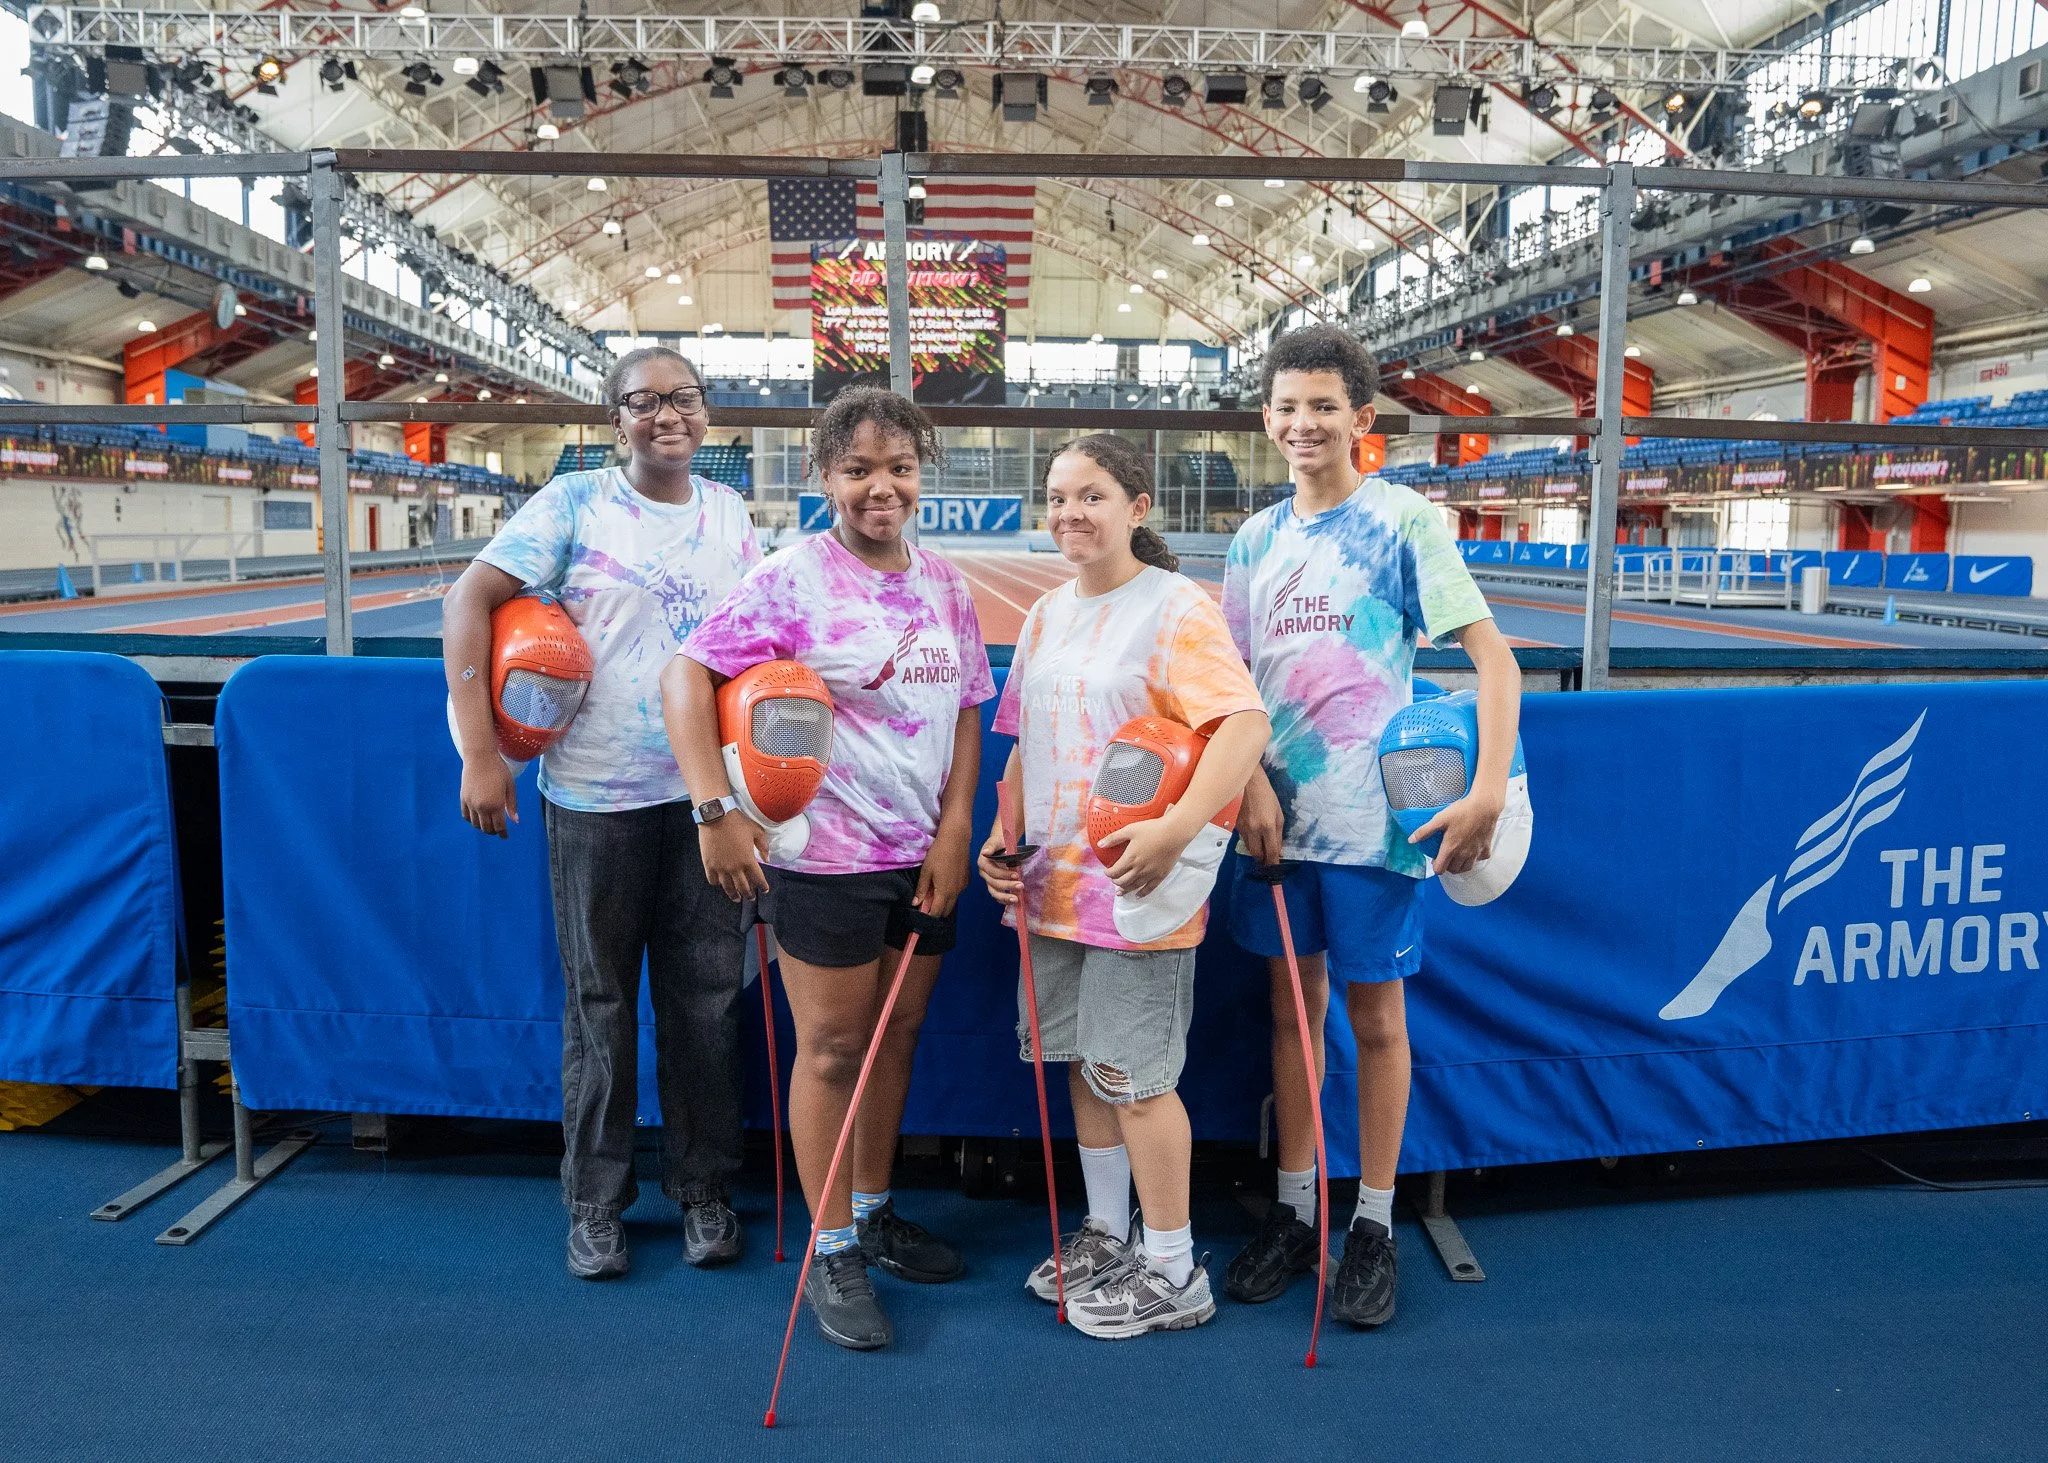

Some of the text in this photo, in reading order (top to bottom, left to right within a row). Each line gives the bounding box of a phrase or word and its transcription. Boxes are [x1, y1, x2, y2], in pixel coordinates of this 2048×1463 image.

[850, 271, 880, 286] DID
[927, 306, 946, 317] the
[859, 318, 877, 329] the
[855, 330, 885, 343] doing
[958, 331, 976, 342] the
[928, 343, 961, 354] record
[918, 500, 989, 530] ORY
[1293, 595, 1330, 614] THE
[1275, 614, 1355, 637] ARMORY
[920, 647, 950, 664] THE
[1051, 673, 1081, 693] THE
[1030, 694, 1108, 716] ARMORY
[1880, 844, 2006, 908] THE
[1793, 911, 2048, 986] ARMOR
